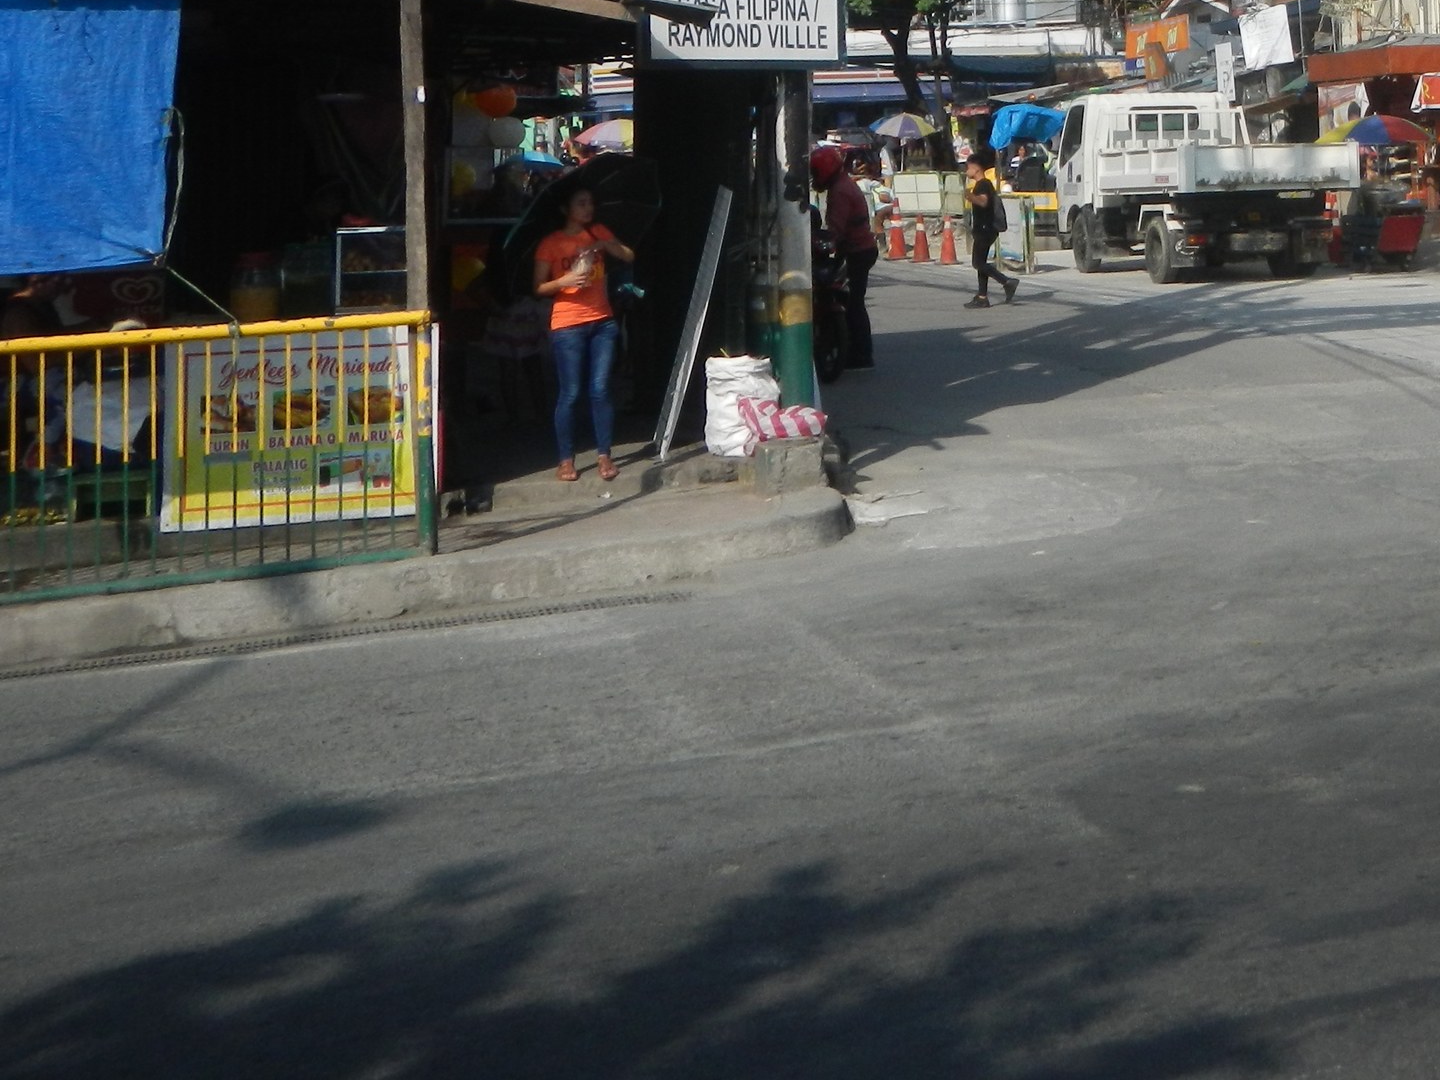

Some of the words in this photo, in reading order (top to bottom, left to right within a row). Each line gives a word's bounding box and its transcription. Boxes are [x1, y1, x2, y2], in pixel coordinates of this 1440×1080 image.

[667, 22, 762, 48] RAYMOND
[767, 24, 828, 50] VILLLE
[209, 439, 249, 452] URON
